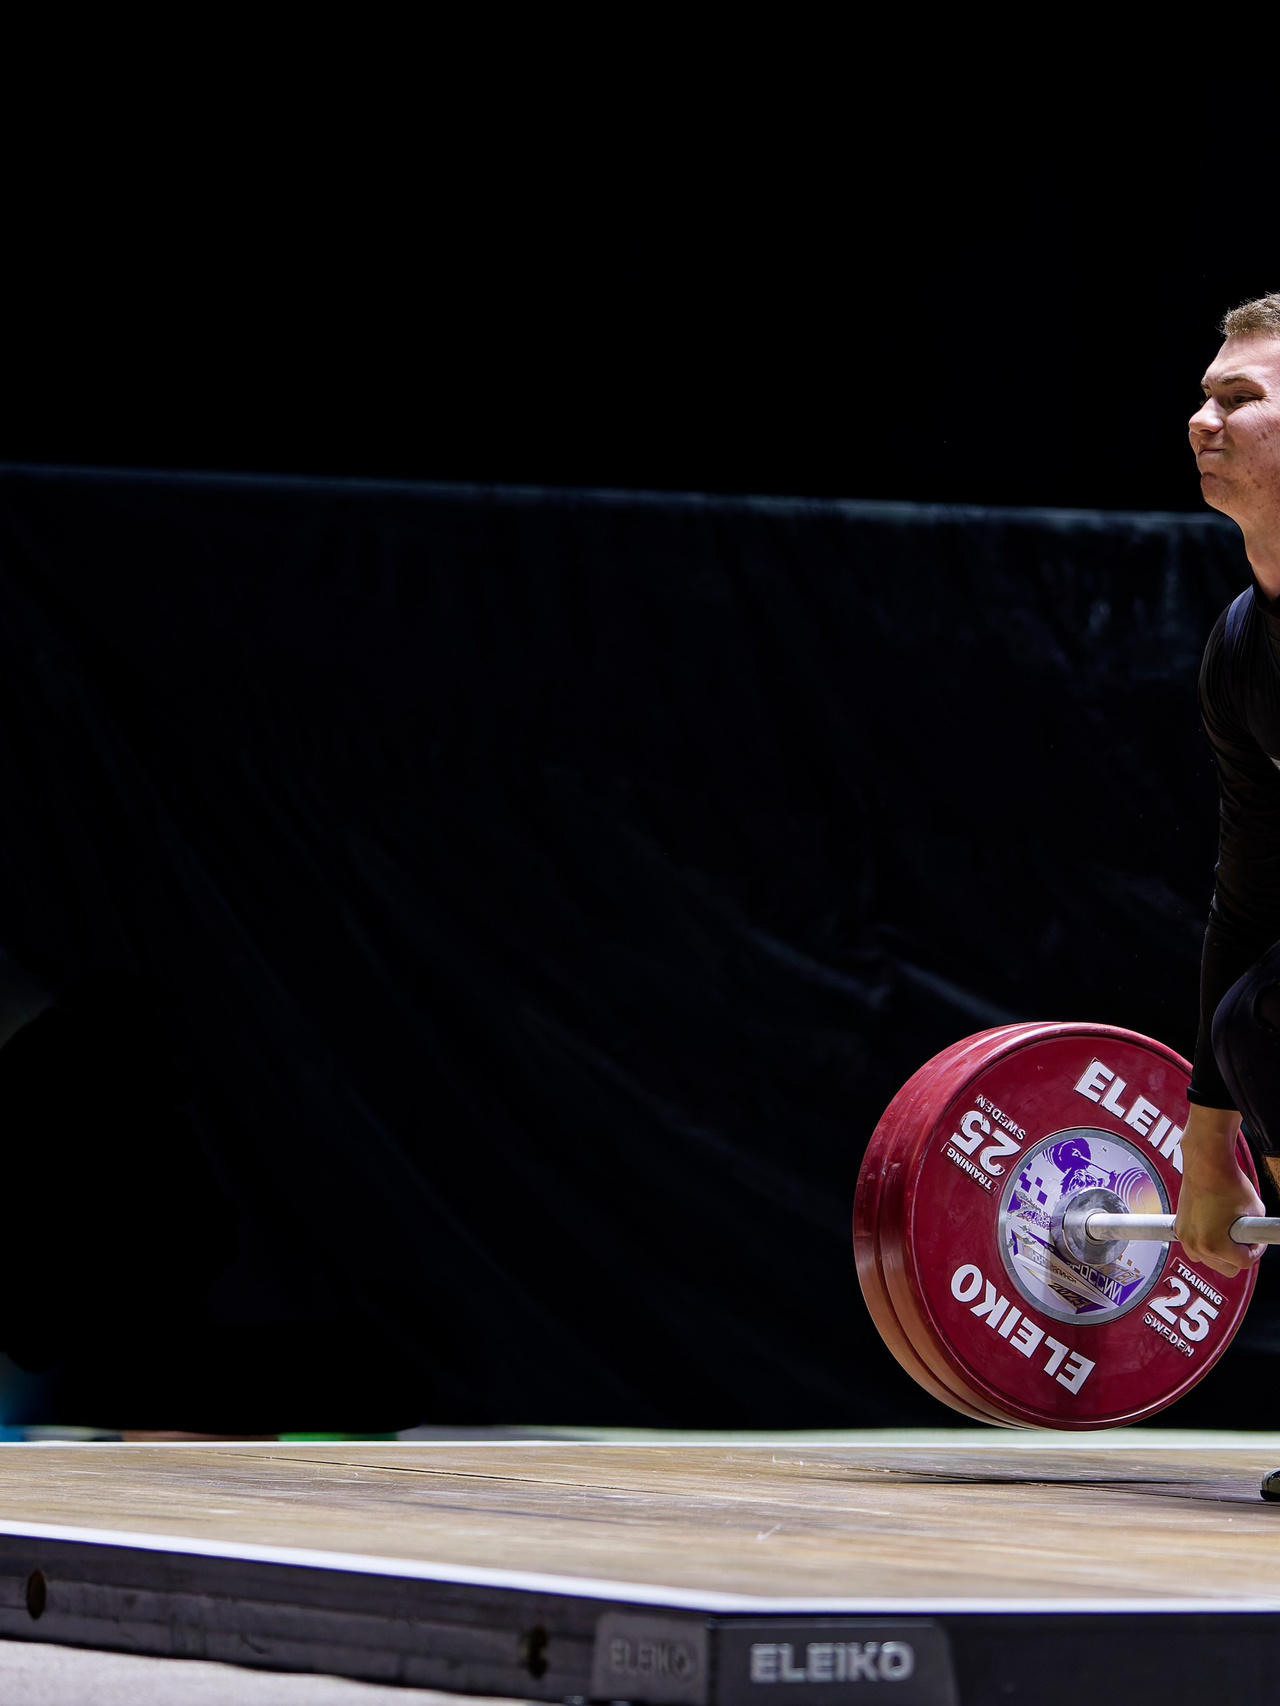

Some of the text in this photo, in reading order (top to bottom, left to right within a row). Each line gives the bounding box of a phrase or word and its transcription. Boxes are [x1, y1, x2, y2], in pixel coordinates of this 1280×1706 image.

[975, 1094, 1026, 1140] SWEDEN
[1073, 1057, 1184, 1174] ELEIK
[950, 1110, 1022, 1177] 25
[946, 1147, 994, 1190] TRAINING
[1177, 1264, 1223, 1306] TRAINING
[951, 1264, 1096, 1395] ELEIKO
[1147, 1276, 1219, 1342] 25
[1144, 1312, 1195, 1357] SWEDEN
[609, 1637, 694, 1677] ELEIKO
[750, 1641, 915, 1683] ELEIKO
